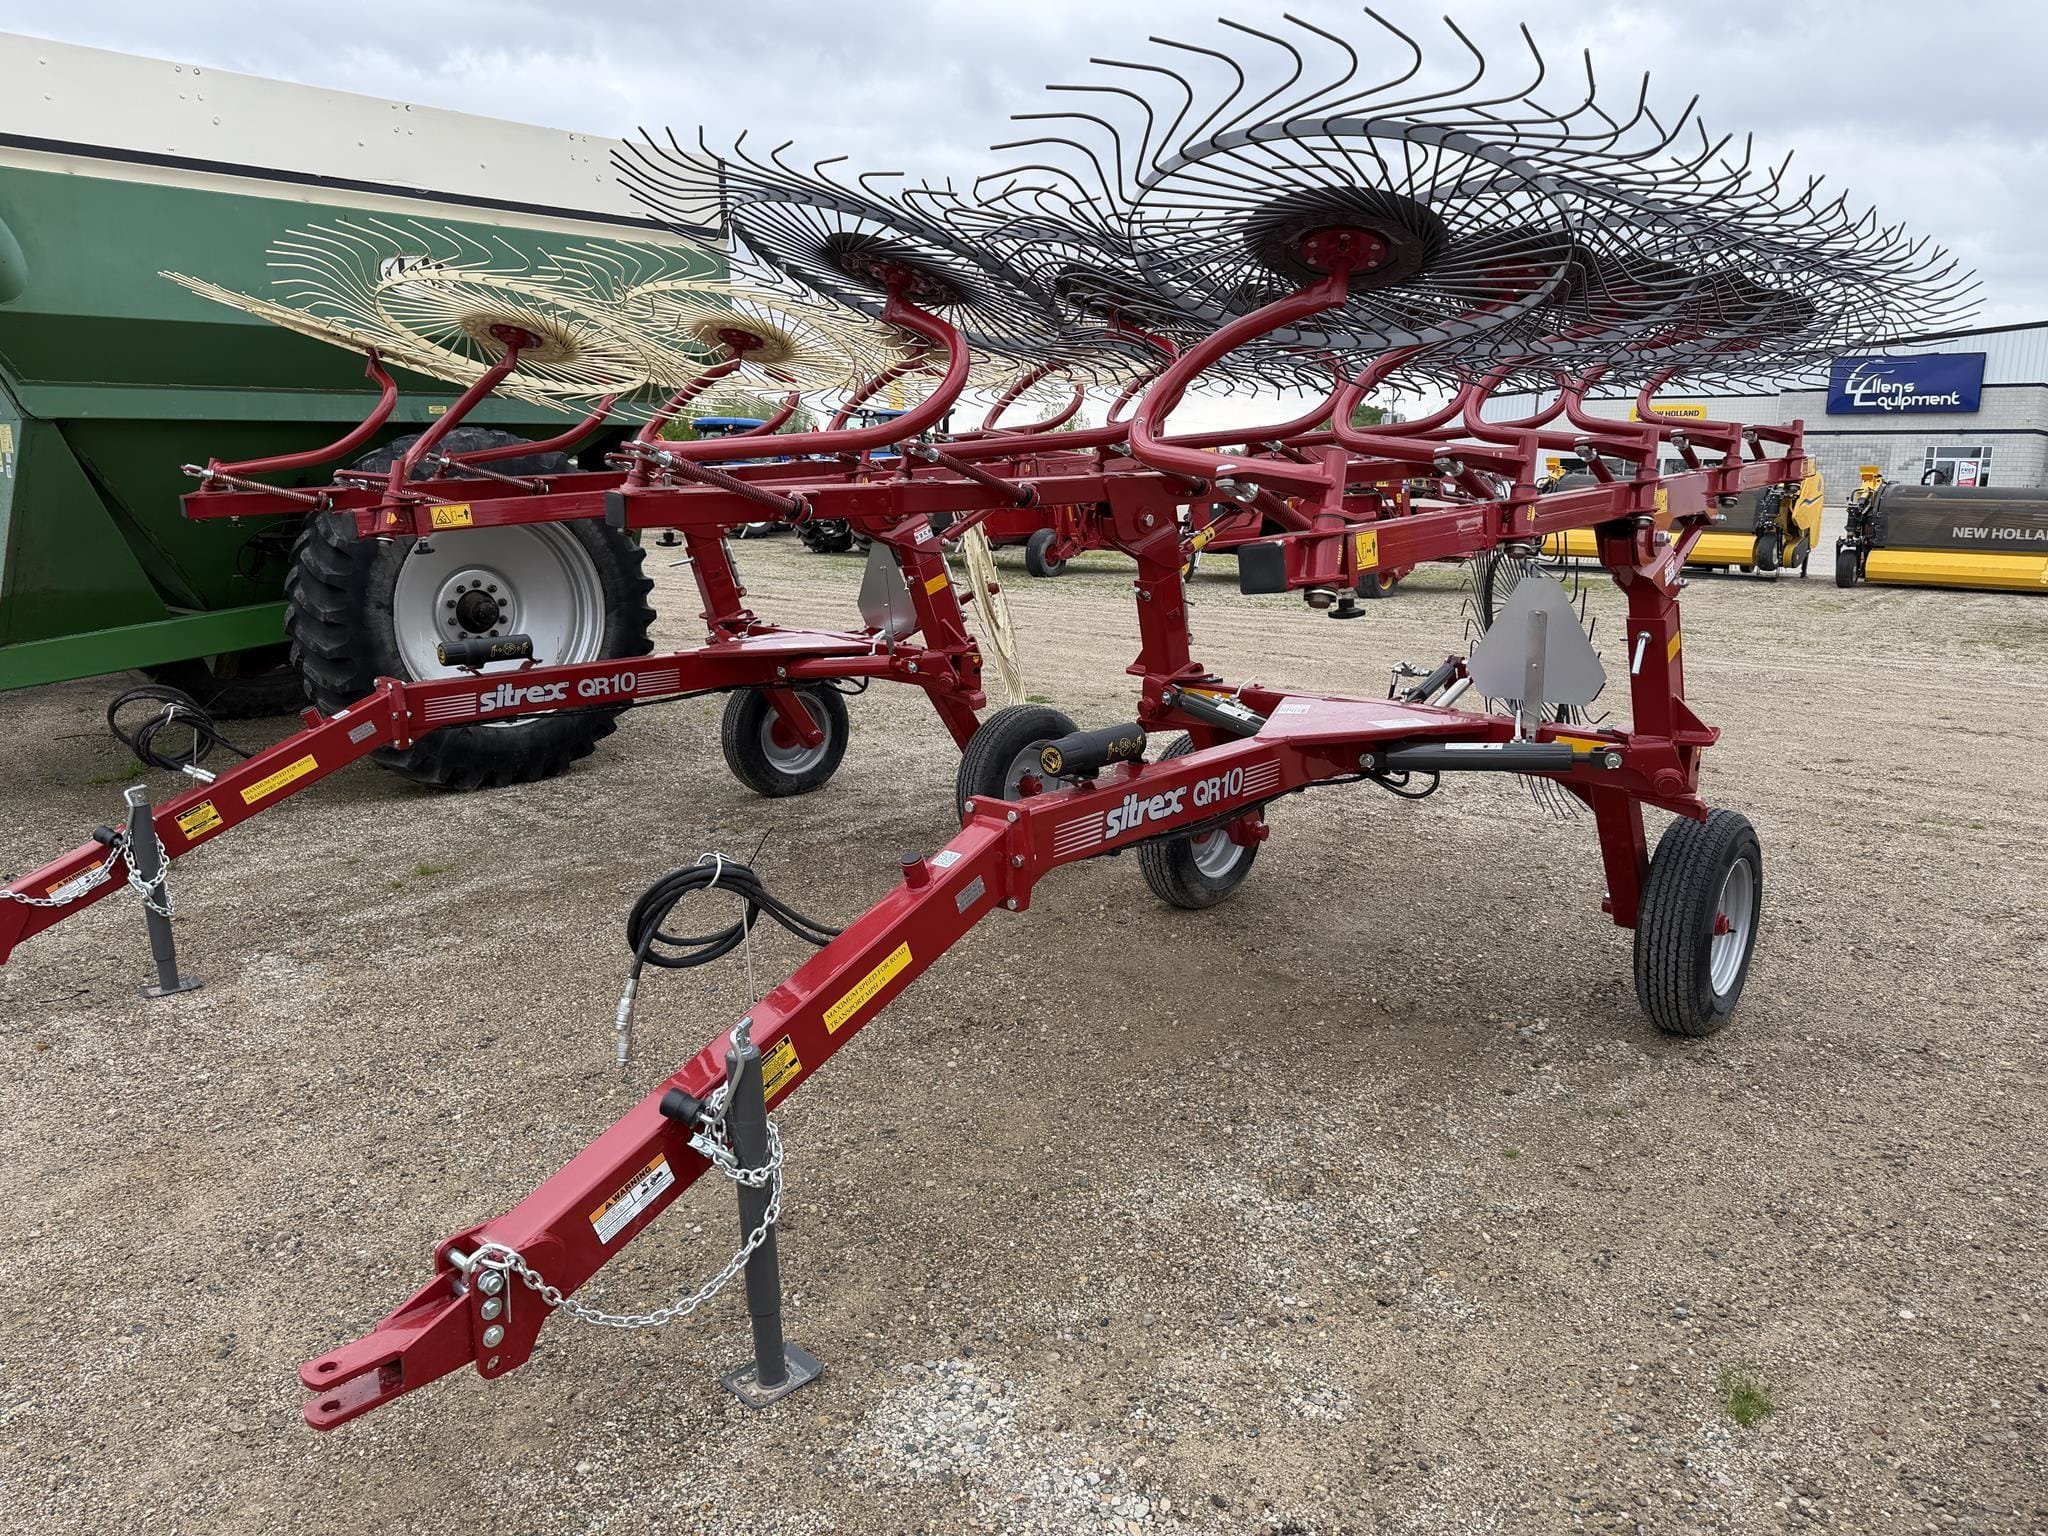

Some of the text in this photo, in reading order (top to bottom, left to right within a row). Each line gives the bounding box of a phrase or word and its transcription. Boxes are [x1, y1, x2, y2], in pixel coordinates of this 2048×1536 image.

[1845, 362, 1915, 395] Ellens
[1853, 373, 1961, 411] Equipment
[1952, 526, 2048, 541] NEW HOLLA
[480, 671, 636, 713] sitrex QR10
[243, 779, 271, 796] MAXIMUM
[270, 770, 287, 784] SPEED
[1105, 766, 1244, 839] sitrex QR10
[63, 866, 92, 887] WARNING
[826, 946, 907, 1020] MAXIMUM SPEED FOR ROAD
[830, 996, 865, 1029] TRANSPORT
[865, 984, 880, 997] MPH
[612, 1165, 652, 1202] WARNING
